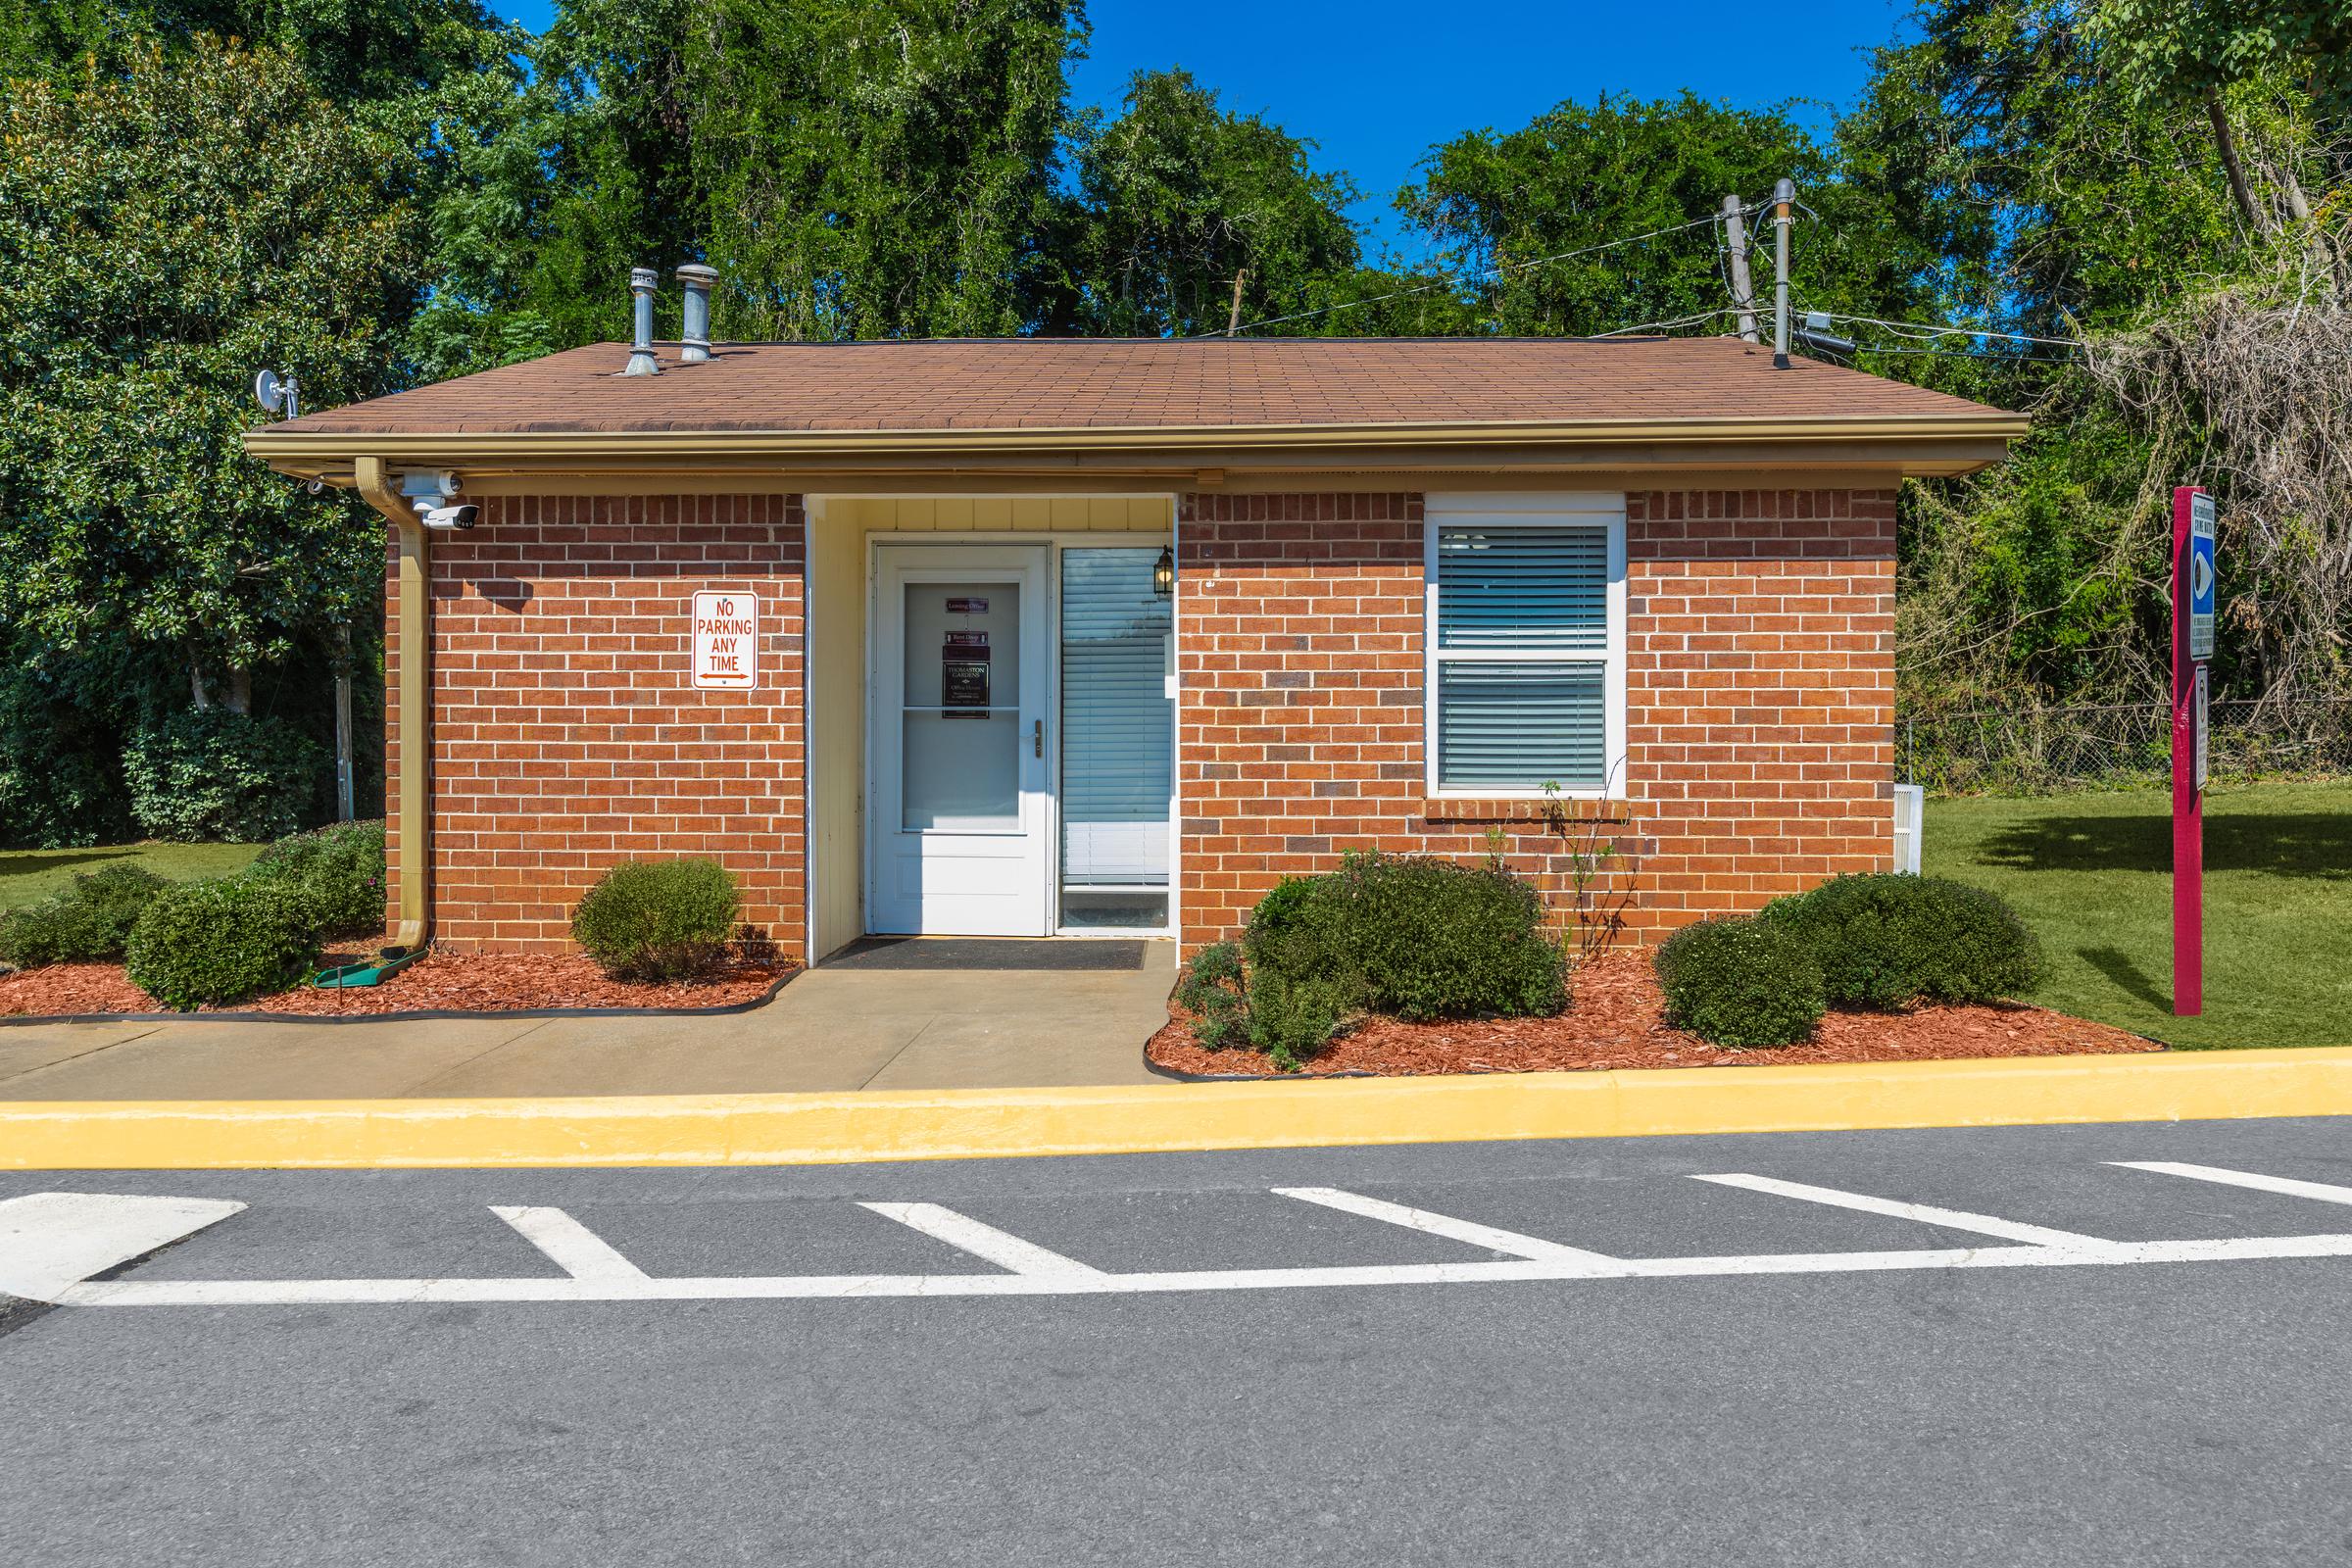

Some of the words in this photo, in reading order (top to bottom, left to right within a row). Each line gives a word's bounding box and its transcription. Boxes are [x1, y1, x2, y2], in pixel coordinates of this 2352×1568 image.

[716, 601, 734, 616] NO
[698, 619, 752, 635] PARKING
[711, 638, 737, 653] ANY
[710, 656, 739, 671] TIME
